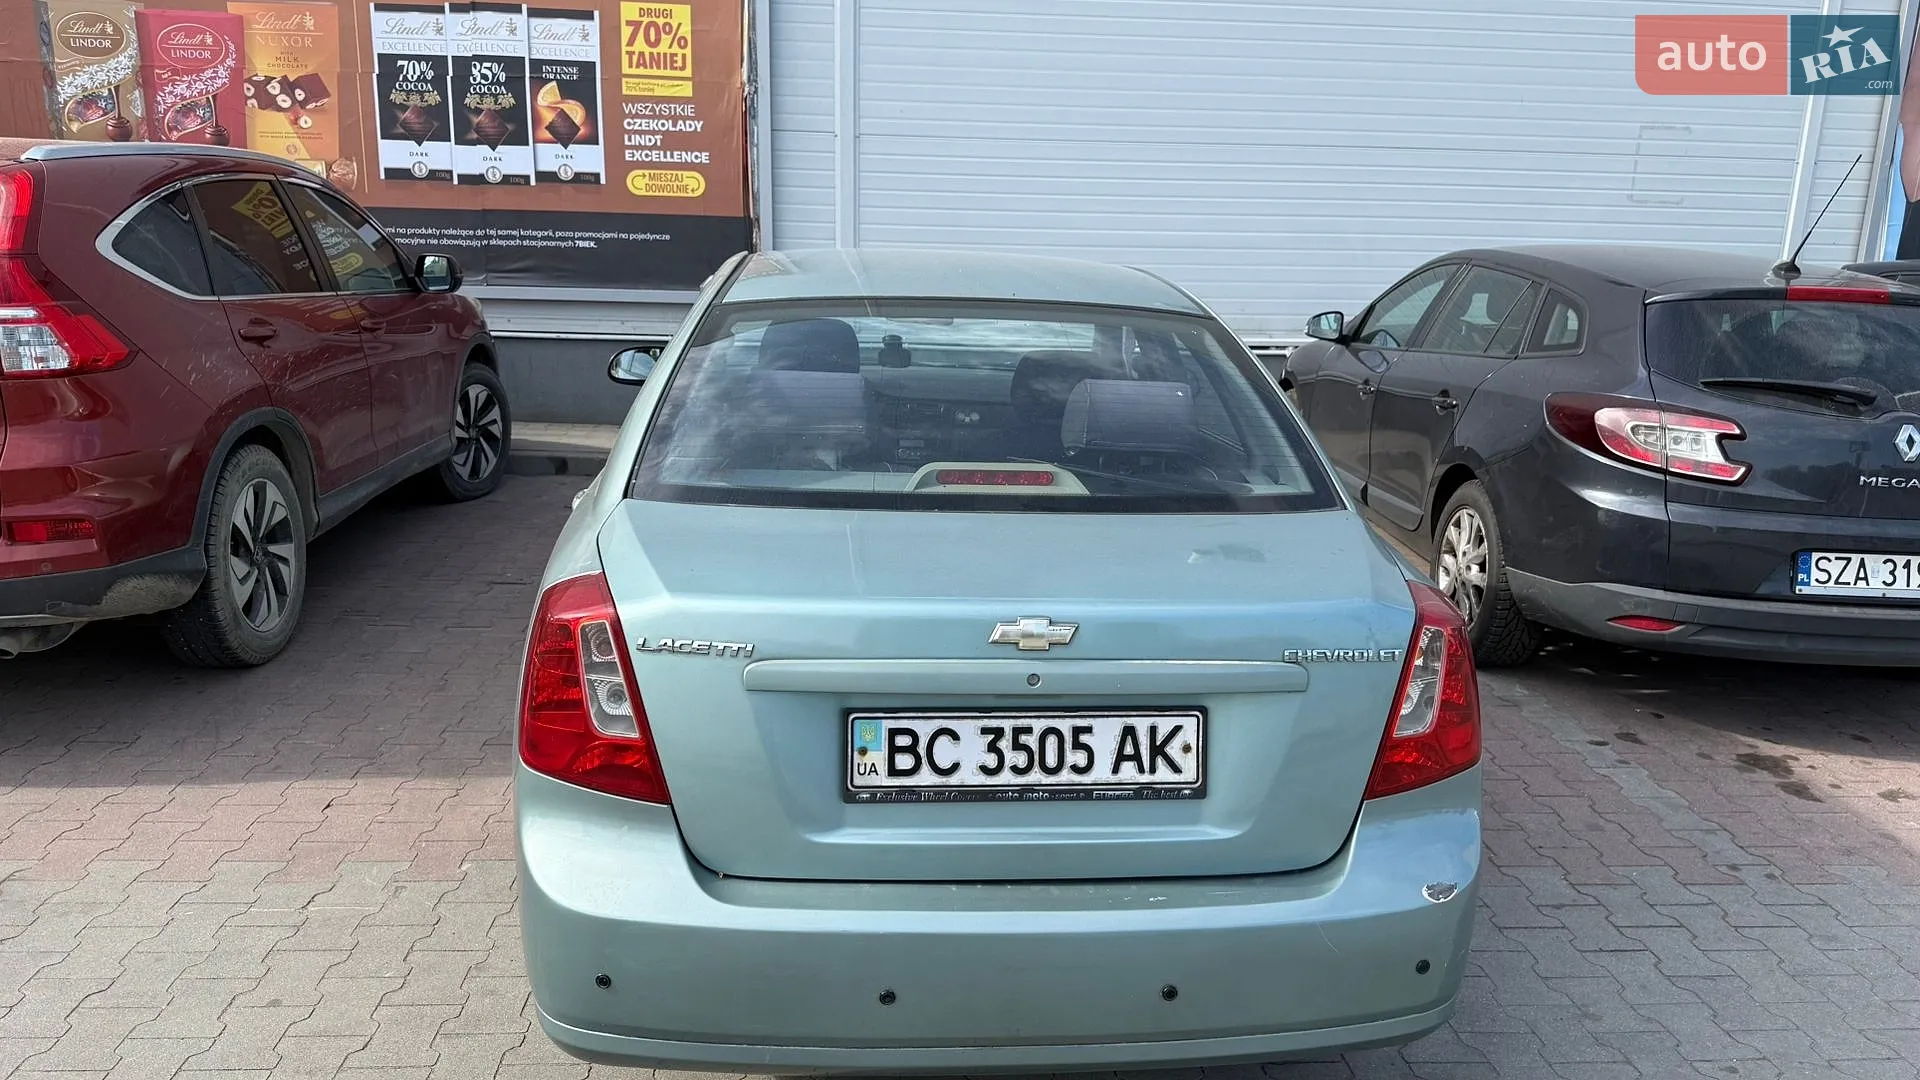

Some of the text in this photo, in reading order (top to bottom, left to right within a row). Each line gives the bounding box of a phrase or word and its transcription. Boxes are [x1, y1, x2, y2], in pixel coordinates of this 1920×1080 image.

[639, 7, 673, 19] DRUGI
[249, 11, 302, 29] Lindt
[381, 17, 432, 35] Lindt
[455, 17, 504, 36] Lindt
[66, 20, 104, 34] Lindt
[530, 23, 577, 41] Lindt
[168, 31, 203, 45] Lindt
[256, 35, 313, 48] NUXOR
[625, 20, 688, 50] 70%
[70, 38, 112, 48] LINDOR
[382, 41, 446, 53] EXCELLENCE
[456, 42, 518, 54] EXCELLENCE
[171, 48, 211, 59] LINDOR
[530, 46, 590, 58] EXCELLENCE
[625, 51, 687, 71] TANIEJ
[396, 60, 434, 81] 70%
[542, 65, 580, 74] INTENSE
[395, 81, 433, 91] COCOA
[470, 85, 507, 94] COCOA
[622, 103, 695, 116] WSZYSTKIE
[623, 119, 703, 132] CZEKOLADY
[624, 134, 662, 146] LINDT
[625, 150, 710, 163] EXCELLENCE
[648, 173, 684, 183] MIESZAJ
[645, 184, 690, 194] DOWOLNIE
[407, 227, 440, 236] produkty
[486, 228, 497, 237] tej
[497, 228, 520, 237] samej
[555, 230, 574, 239] poza
[574, 230, 618, 240] promocjami
[629, 231, 671, 241] pojedyncze
[427, 236, 438, 245] nie
[489, 238, 522, 247] sklepach
[522, 238, 574, 248] stacjonarnych
[1798, 573, 1809, 582] PL
[1814, 556, 1920, 588] SZA 31
[636, 636, 755, 658] LACETTI
[1283, 648, 1402, 663] CHEVROLET
[886, 724, 1184, 778] BC 3505 AK
[857, 761, 879, 777] UA
